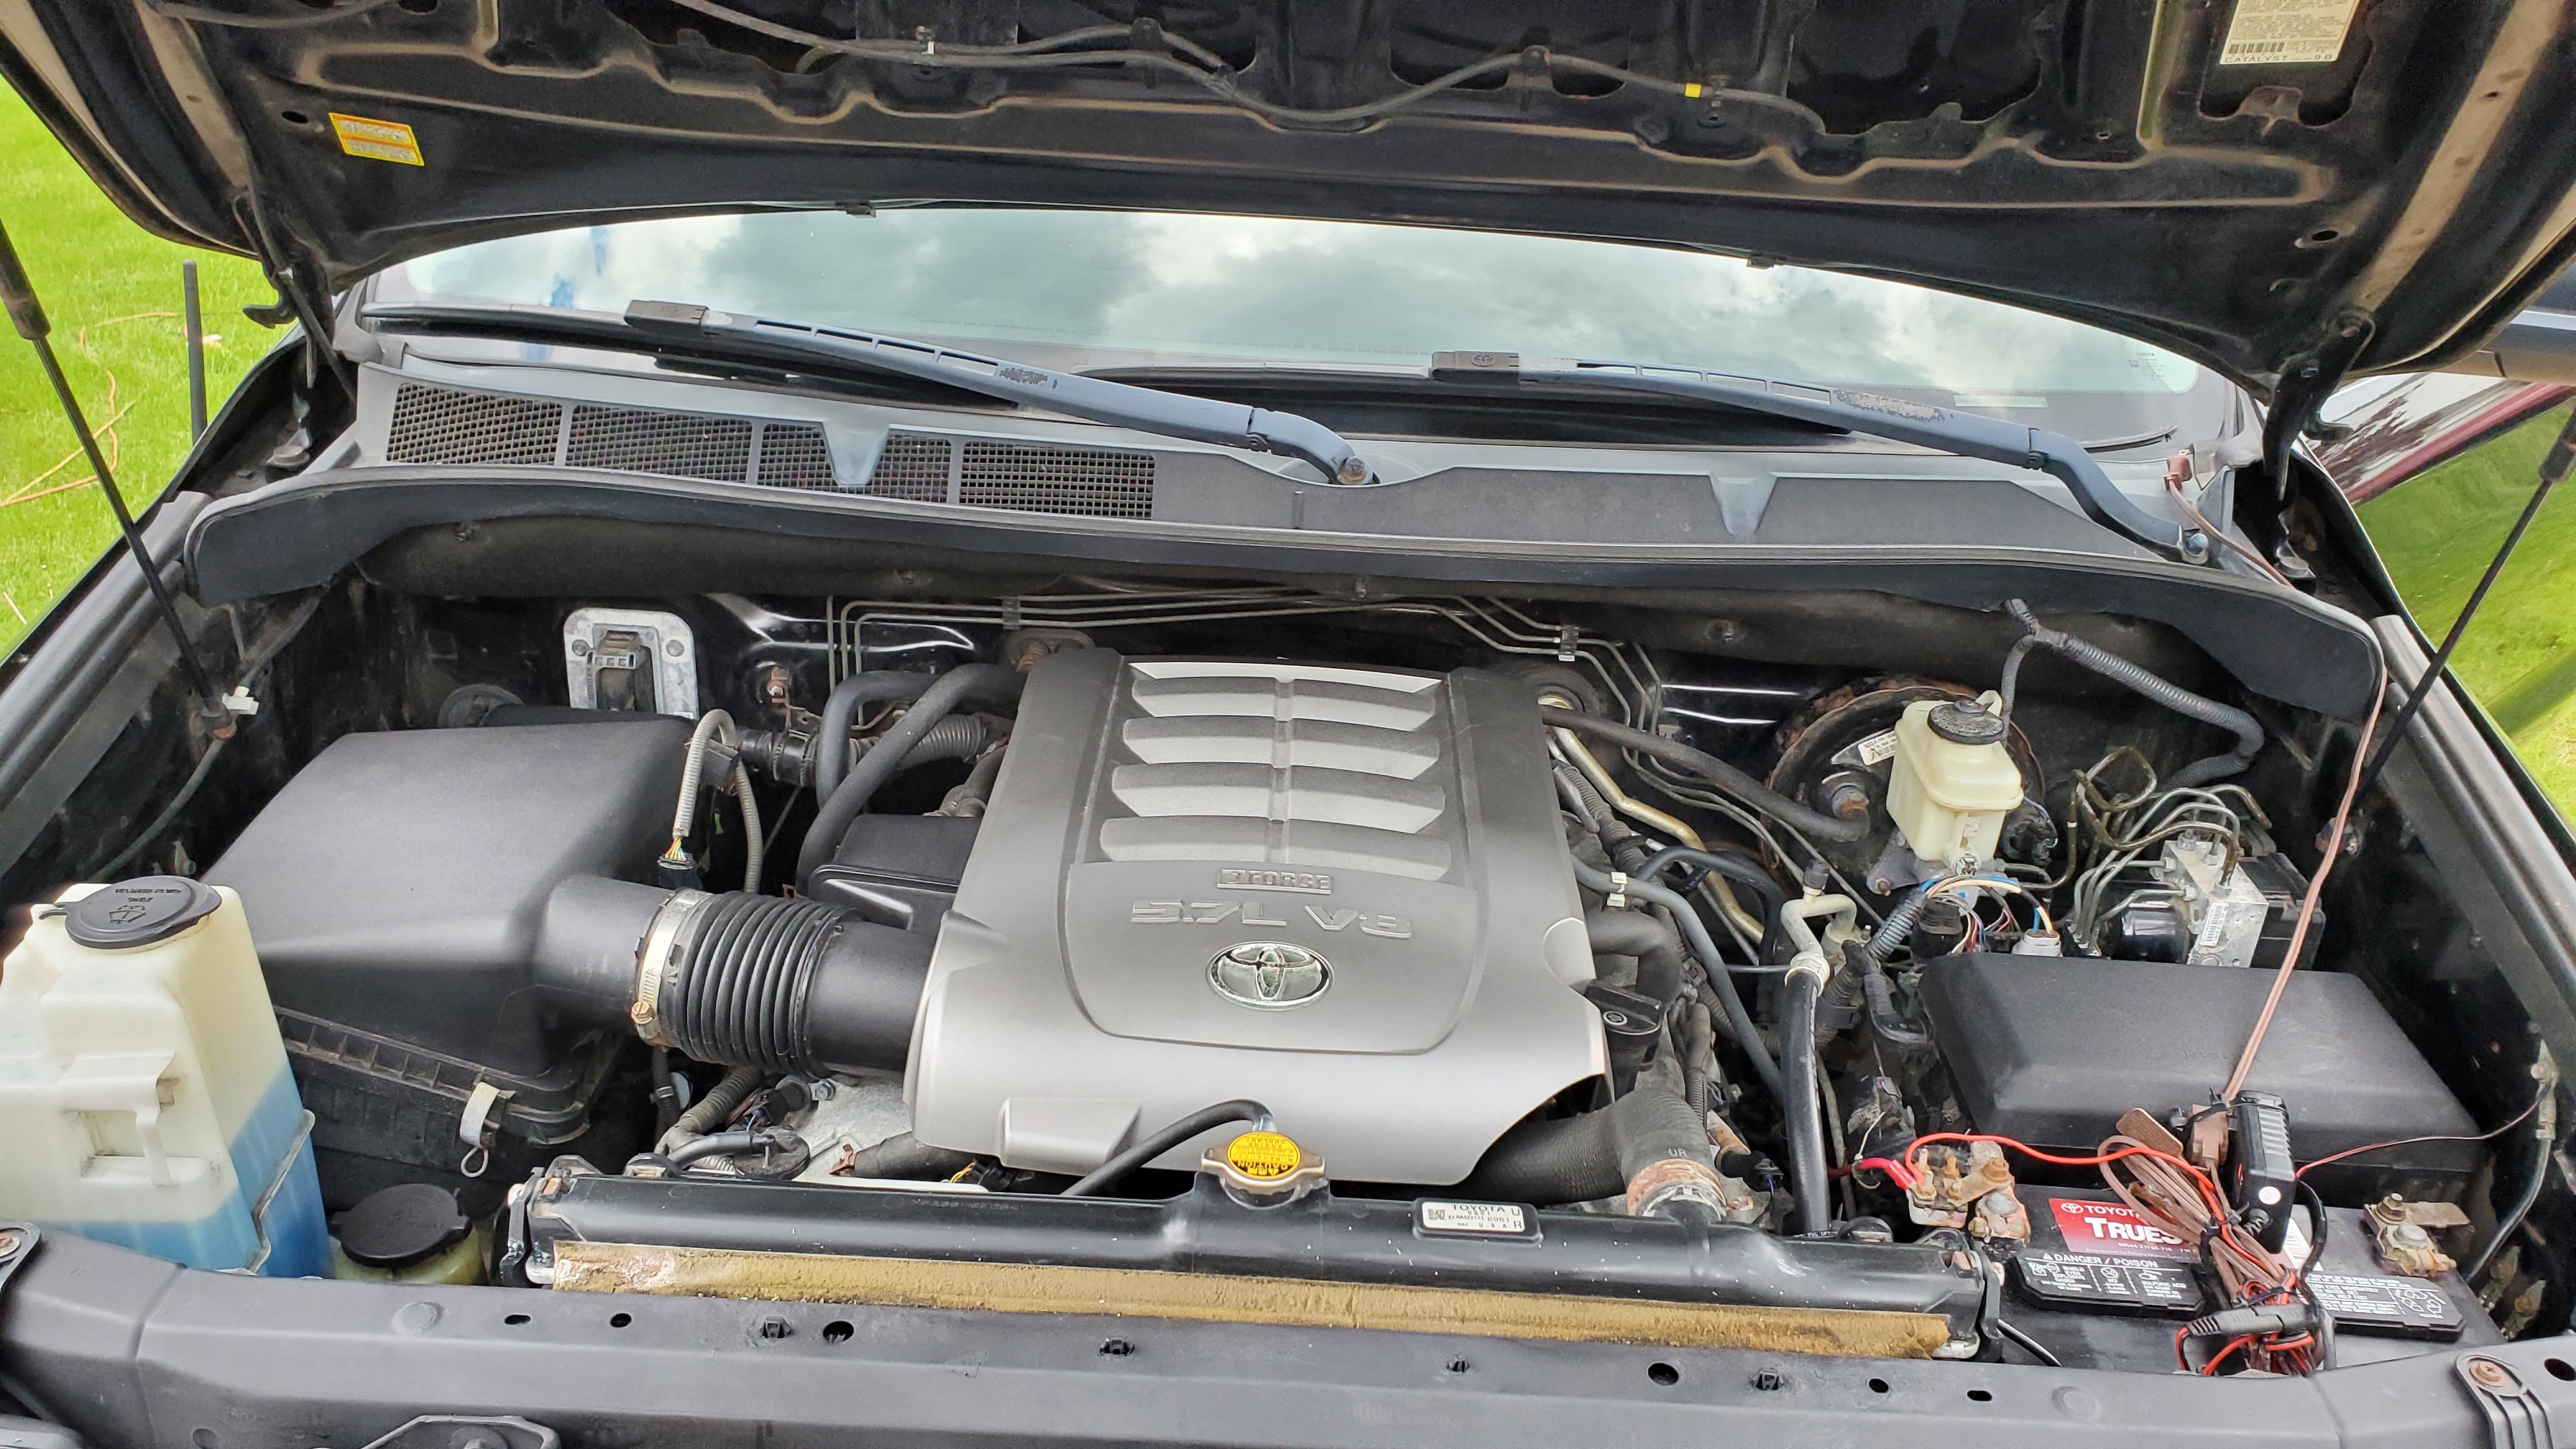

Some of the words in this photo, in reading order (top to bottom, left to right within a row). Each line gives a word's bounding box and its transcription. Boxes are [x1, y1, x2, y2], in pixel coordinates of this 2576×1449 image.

[2225, 55, 2289, 63] CATALYST
[1131, 900, 1287, 926] 5.7L
[1304, 904, 1412, 939] V8
[1668, 1148, 1687, 1157] UR
[1238, 1160, 1288, 1170] CAUTION
[1514, 1220, 1522, 1229] R
[2053, 1254, 2105, 1264] DANGER
[2112, 1257, 2159, 1268] POISON
